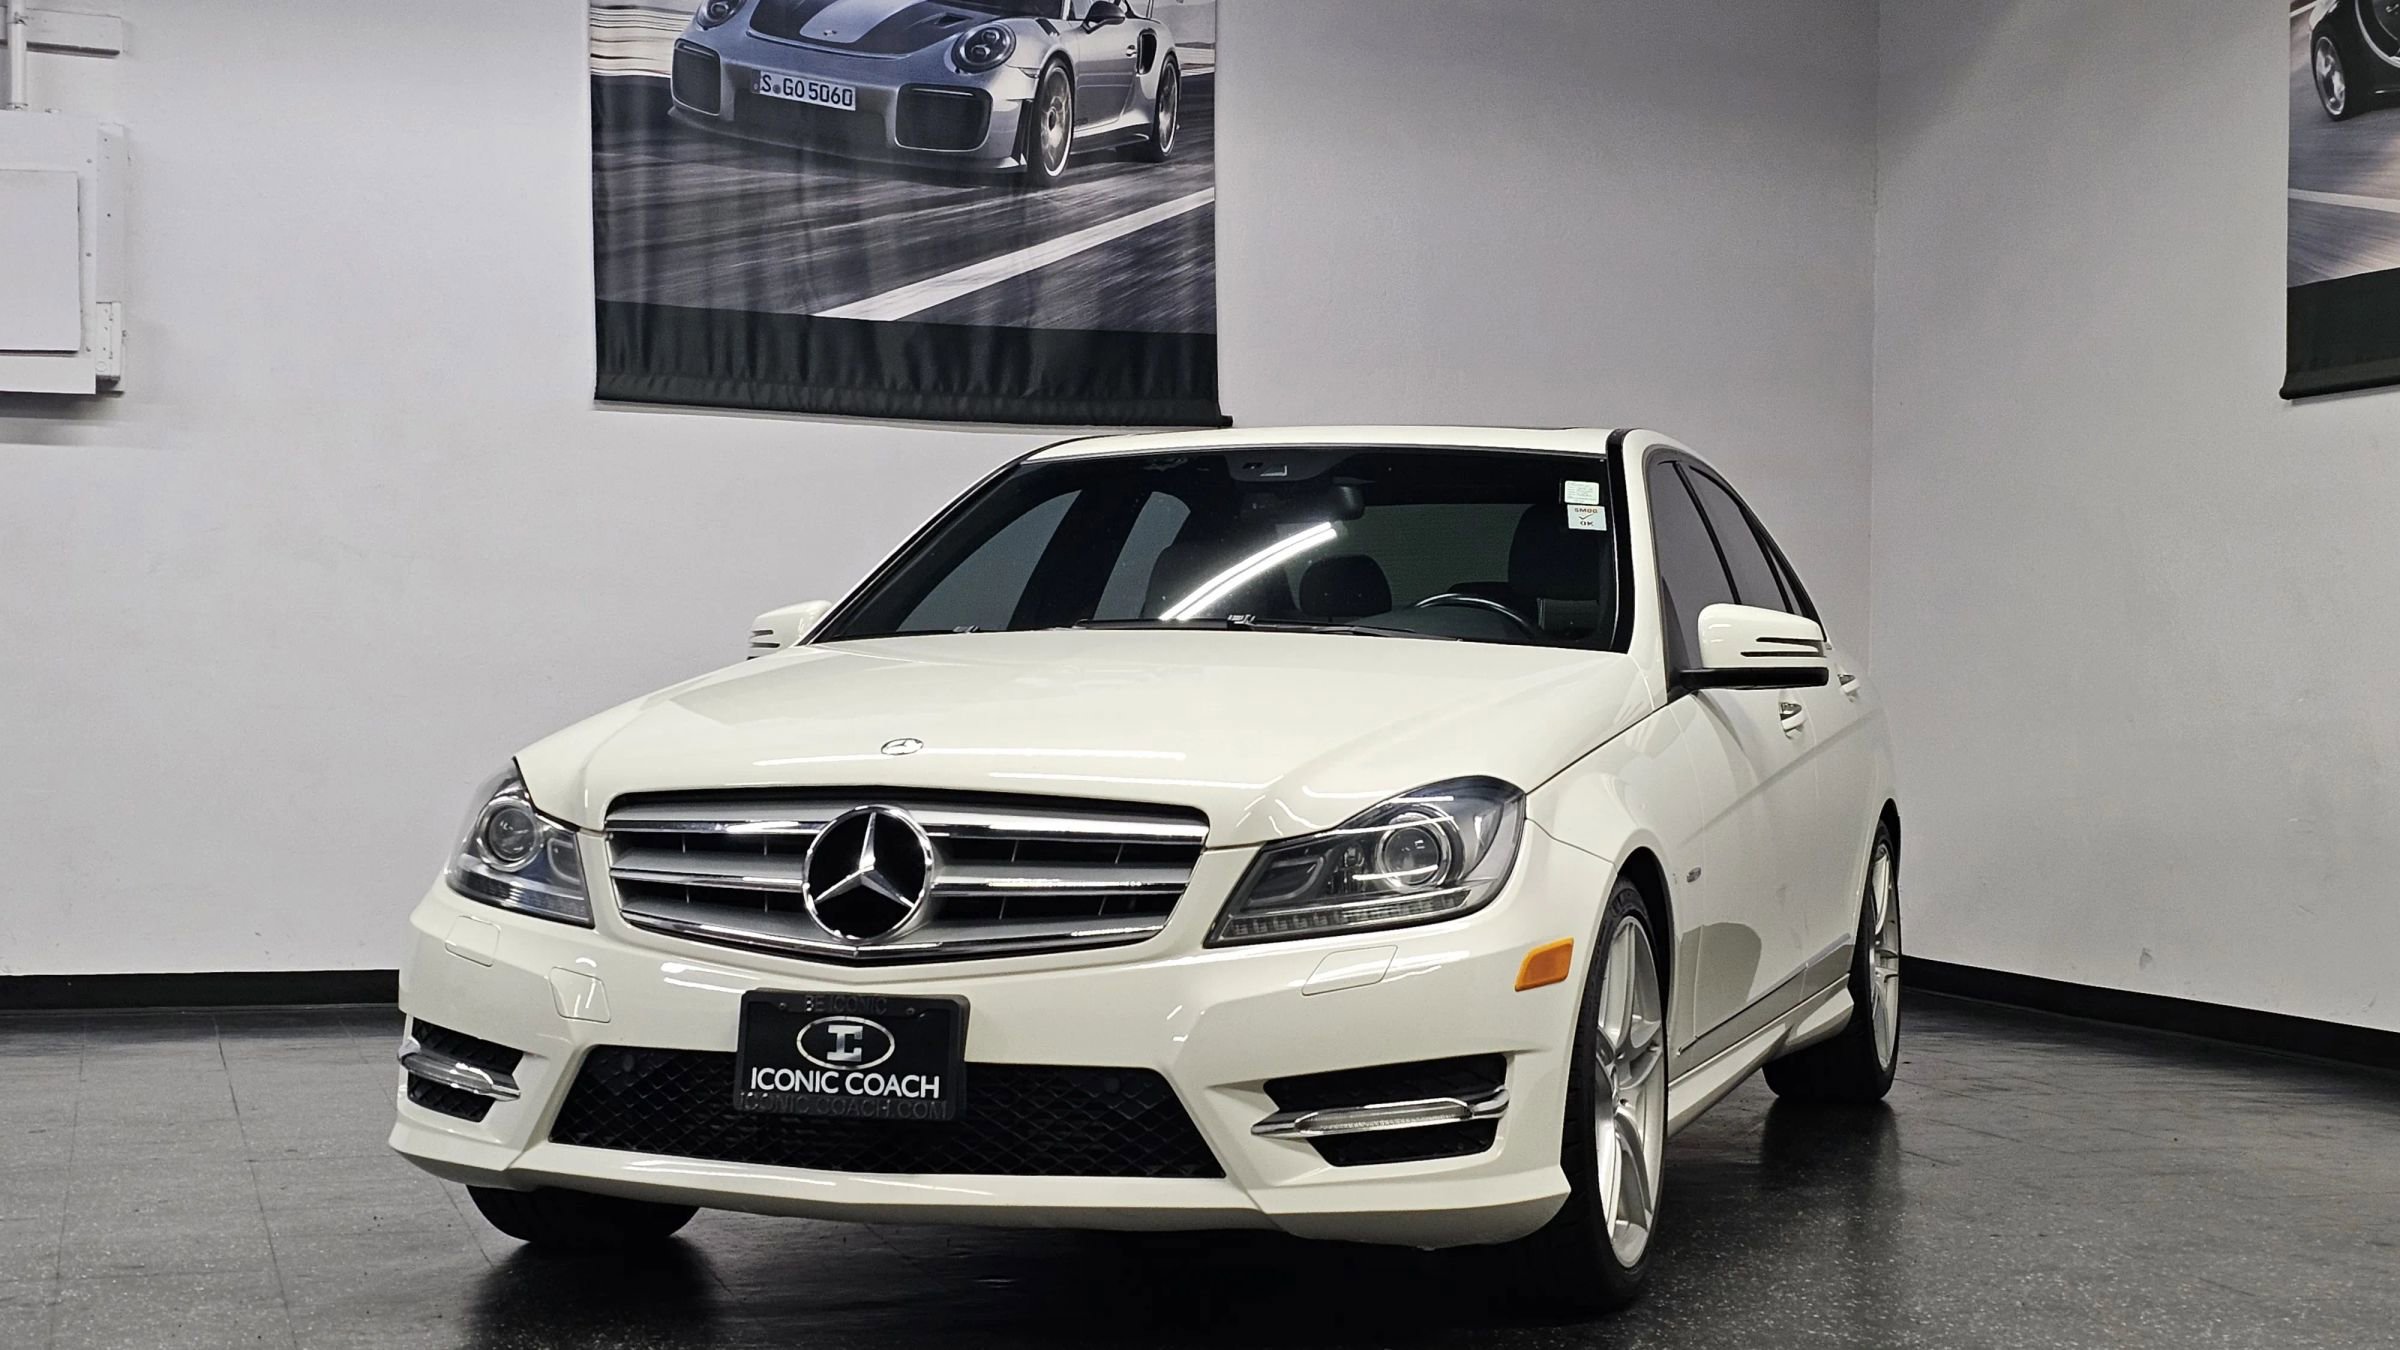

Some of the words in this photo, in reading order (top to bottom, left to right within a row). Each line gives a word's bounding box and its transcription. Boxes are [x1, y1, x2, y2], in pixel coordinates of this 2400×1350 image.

[761, 74, 772, 92] S
[783, 78, 805, 98] GO
[808, 82, 853, 106] 5060
[804, 994, 825, 1012] BE
[831, 995, 888, 1015] ICONIC
[751, 1067, 840, 1094] ICONIC
[844, 1072, 941, 1099] COACH
